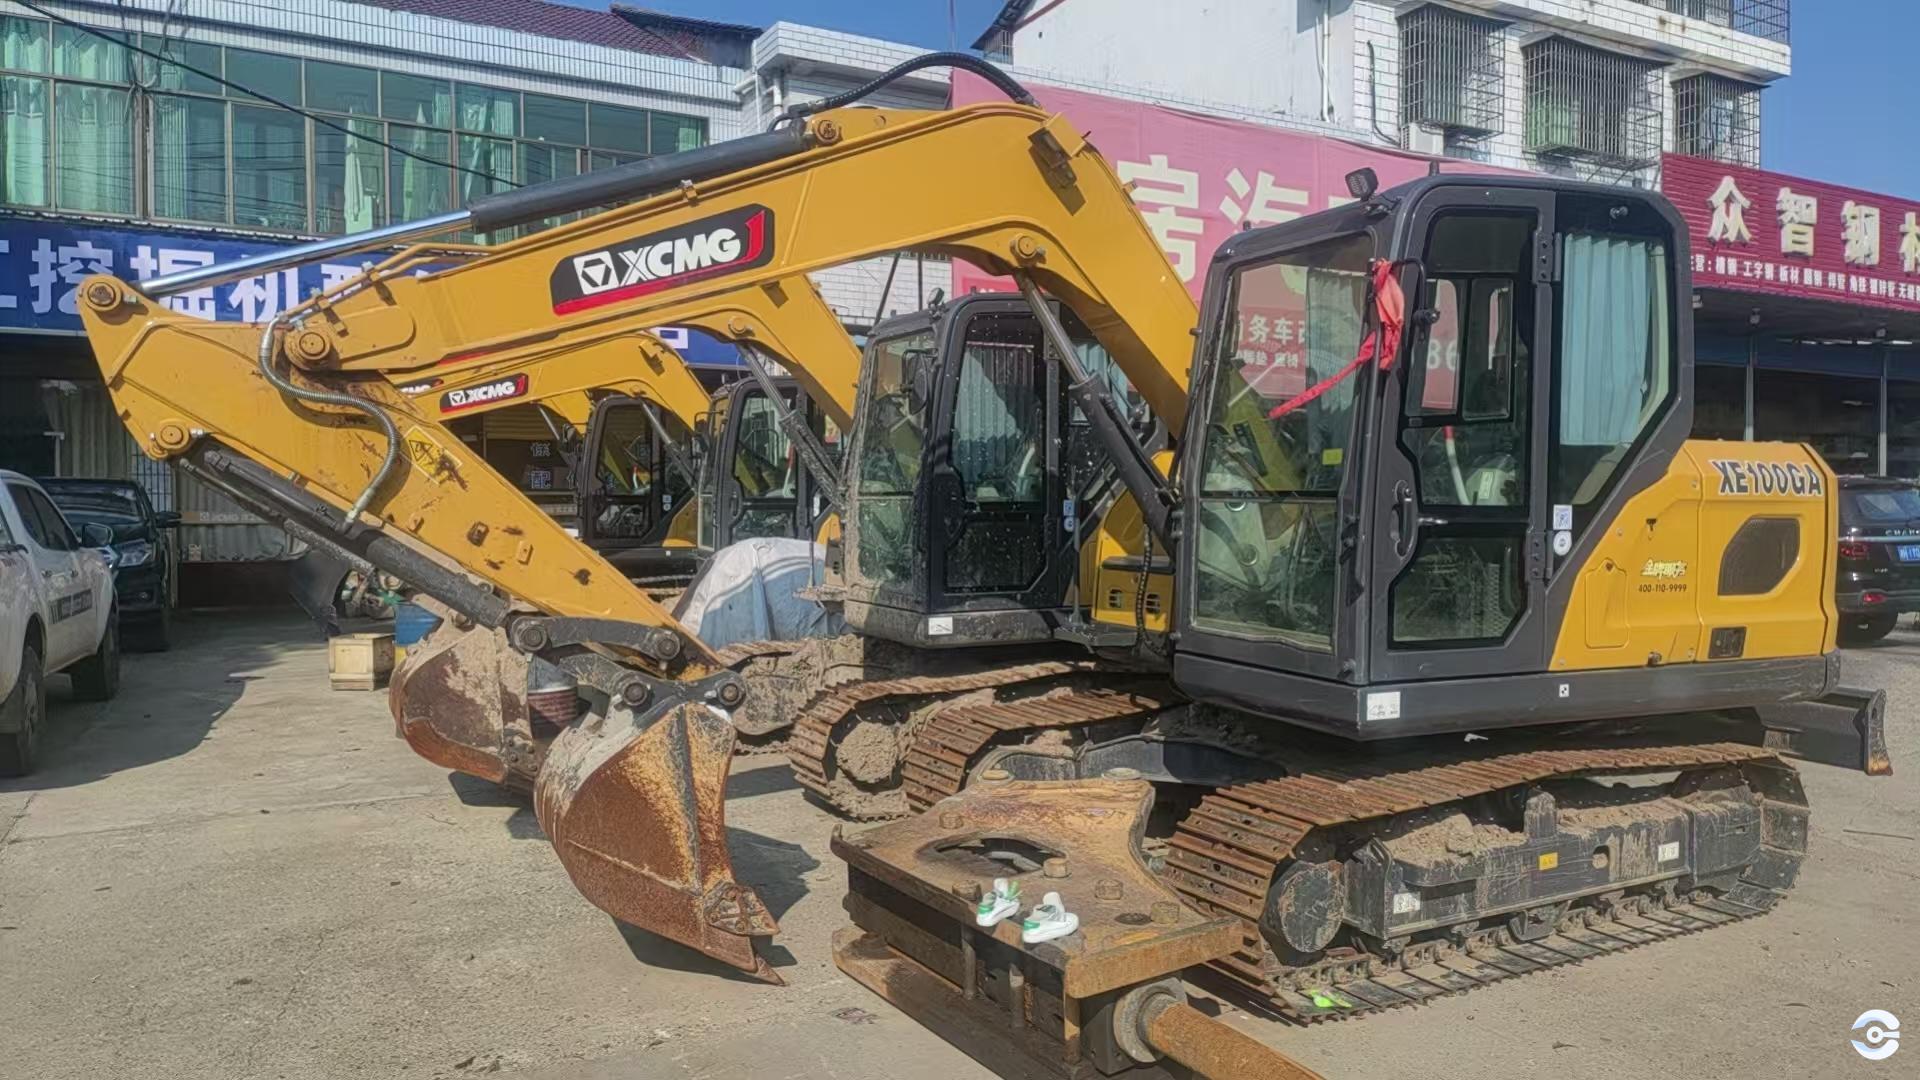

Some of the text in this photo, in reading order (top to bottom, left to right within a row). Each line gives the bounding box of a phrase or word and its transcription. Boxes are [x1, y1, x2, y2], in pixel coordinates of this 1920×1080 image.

[618, 228, 741, 288] XCMG
[467, 381, 515, 402] XCMG
[1709, 460, 1823, 496] XE100GA
[1638, 584, 1688, 592] 400-110-9999
